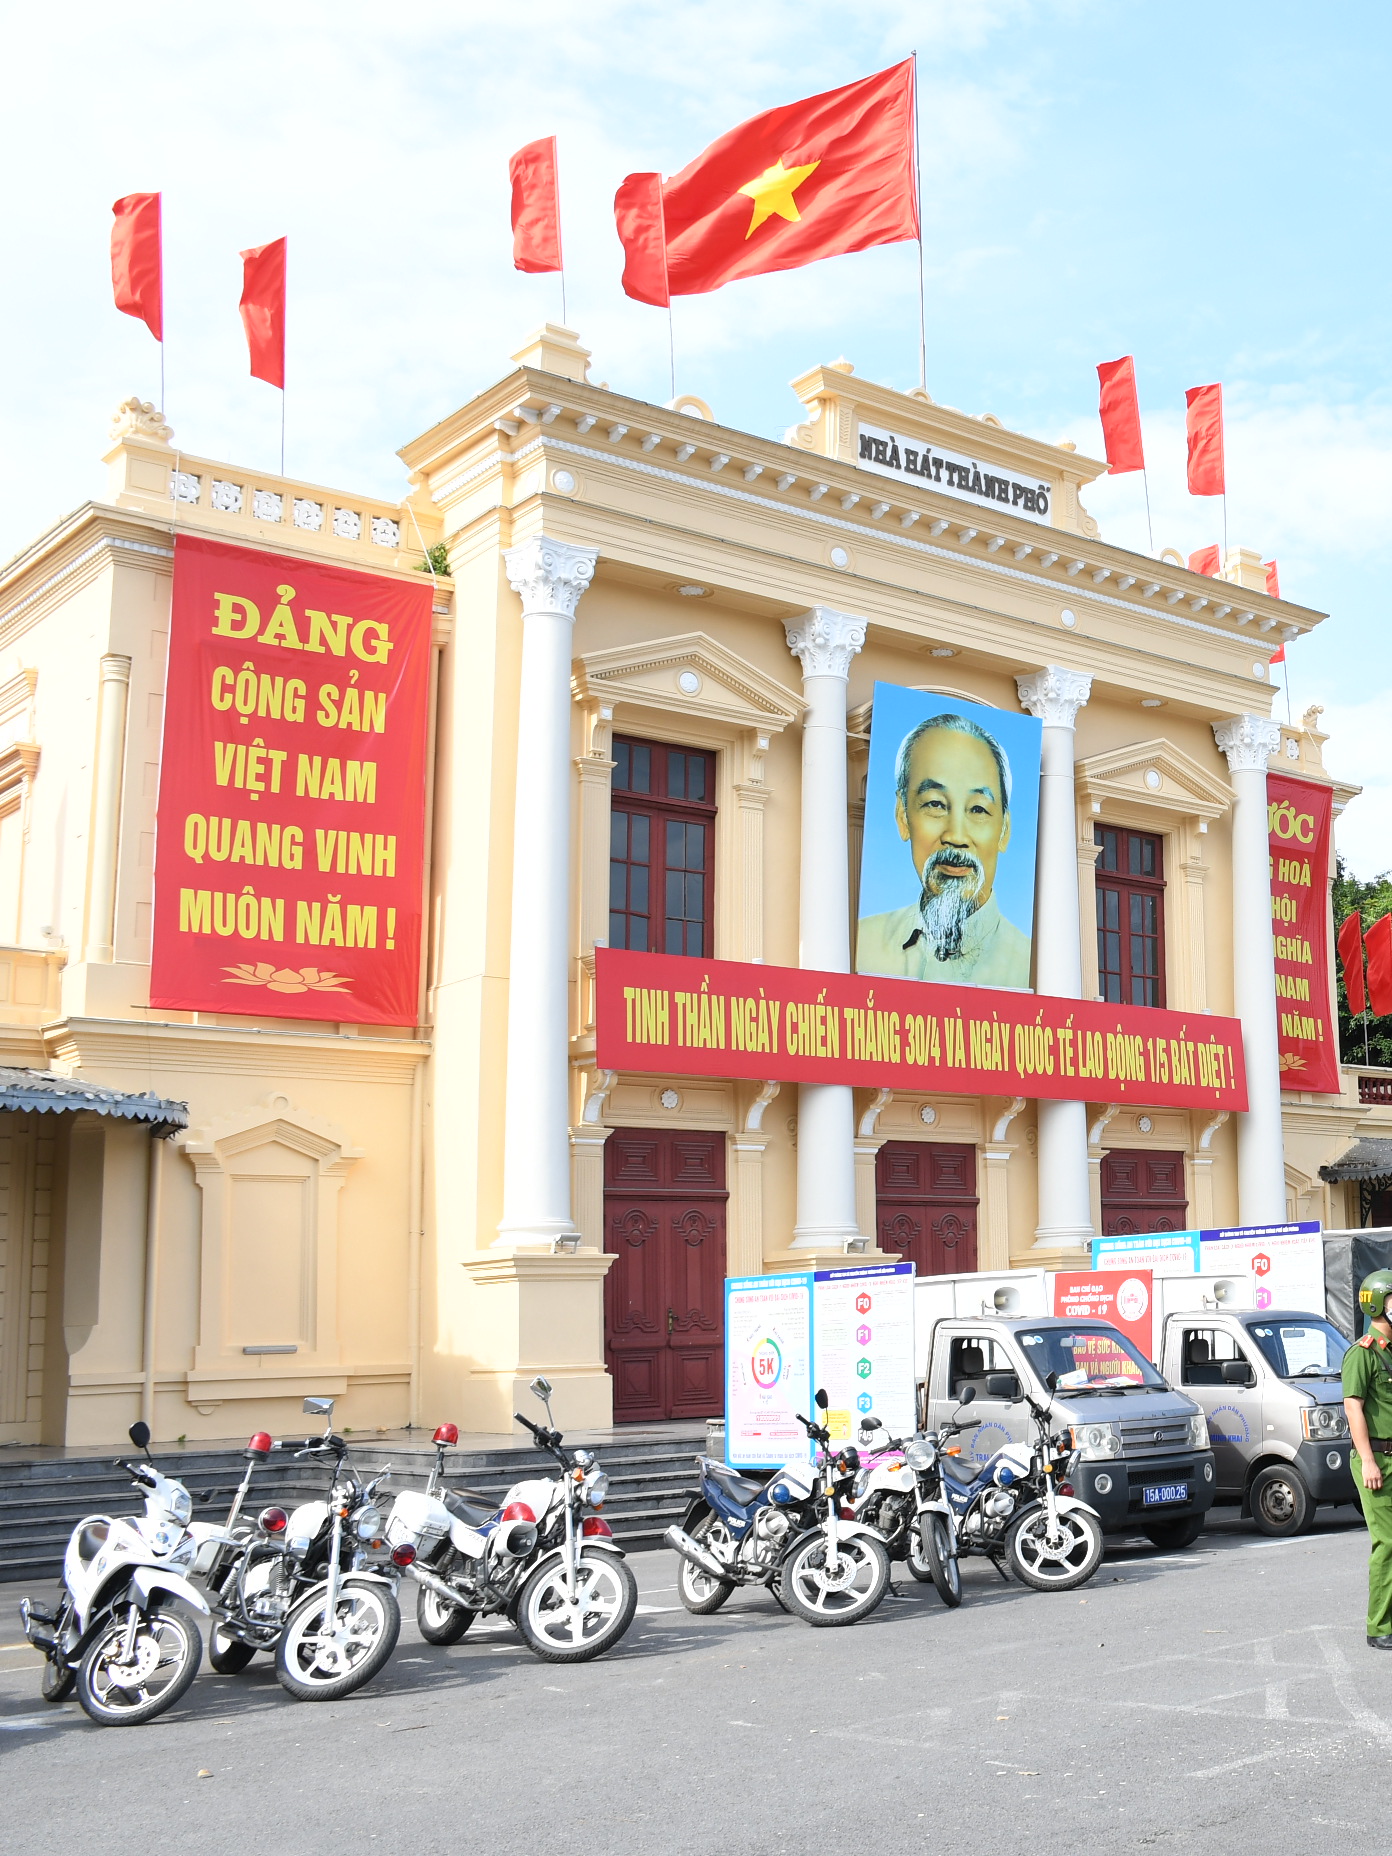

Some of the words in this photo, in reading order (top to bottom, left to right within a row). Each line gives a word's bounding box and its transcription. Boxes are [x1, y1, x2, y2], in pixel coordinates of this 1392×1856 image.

[859, 433, 901, 470] NHÀ
[904, 447, 943, 482] HÁT
[945, 462, 1010, 503] THÀNH
[1012, 483, 1051, 516] PHỐ
[212, 584, 394, 664] ĐẢNG
[211, 661, 305, 725] CỘNG
[317, 669, 386, 734] SẢN
[214, 738, 287, 801] VIỆT
[296, 754, 377, 804] NAM
[184, 813, 303, 870] QUANG
[315, 829, 397, 878] VINH
[1278, 858, 1312, 888] HOÀ
[179, 886, 285, 942] MUÔN
[296, 894, 378, 949] NĂM
[1271, 893, 1297, 927] HỘI
[1275, 973, 1310, 1002] NAM
[623, 986, 670, 1046] TINH
[674, 974, 726, 1050] THẦN
[731, 987, 780, 1054] NGÀY
[786, 988, 840, 1059] CHIẾN
[843, 989, 901, 1064] THẮNG
[904, 1013, 941, 1067] 30/4
[944, 1007, 967, 1068] VÀ
[969, 1010, 1011, 1072] NGÀY
[1014, 1009, 1054, 1079] QUỐC
[1056, 1014, 1075, 1078] TẾ
[1077, 1030, 1104, 1079] LAO
[1106, 1023, 1145, 1091] ĐỘNG
[1147, 1036, 1169, 1084] 1/5
[1170, 1024, 1196, 1086] BẤT
[1198, 1034, 1226, 1099] DIỆT
[1253, 1259, 1268, 1271] F0
[857, 1298, 870, 1310] F0
[1065, 1305, 1091, 1316] COVID
[1256, 1292, 1268, 1304] F1
[857, 1330, 869, 1341] F1
[758, 1357, 774, 1376] 5K
[858, 1362, 871, 1374] F2
[859, 1397, 871, 1409] F3
[1145, 1485, 1186, 1503] 15A-000.25
